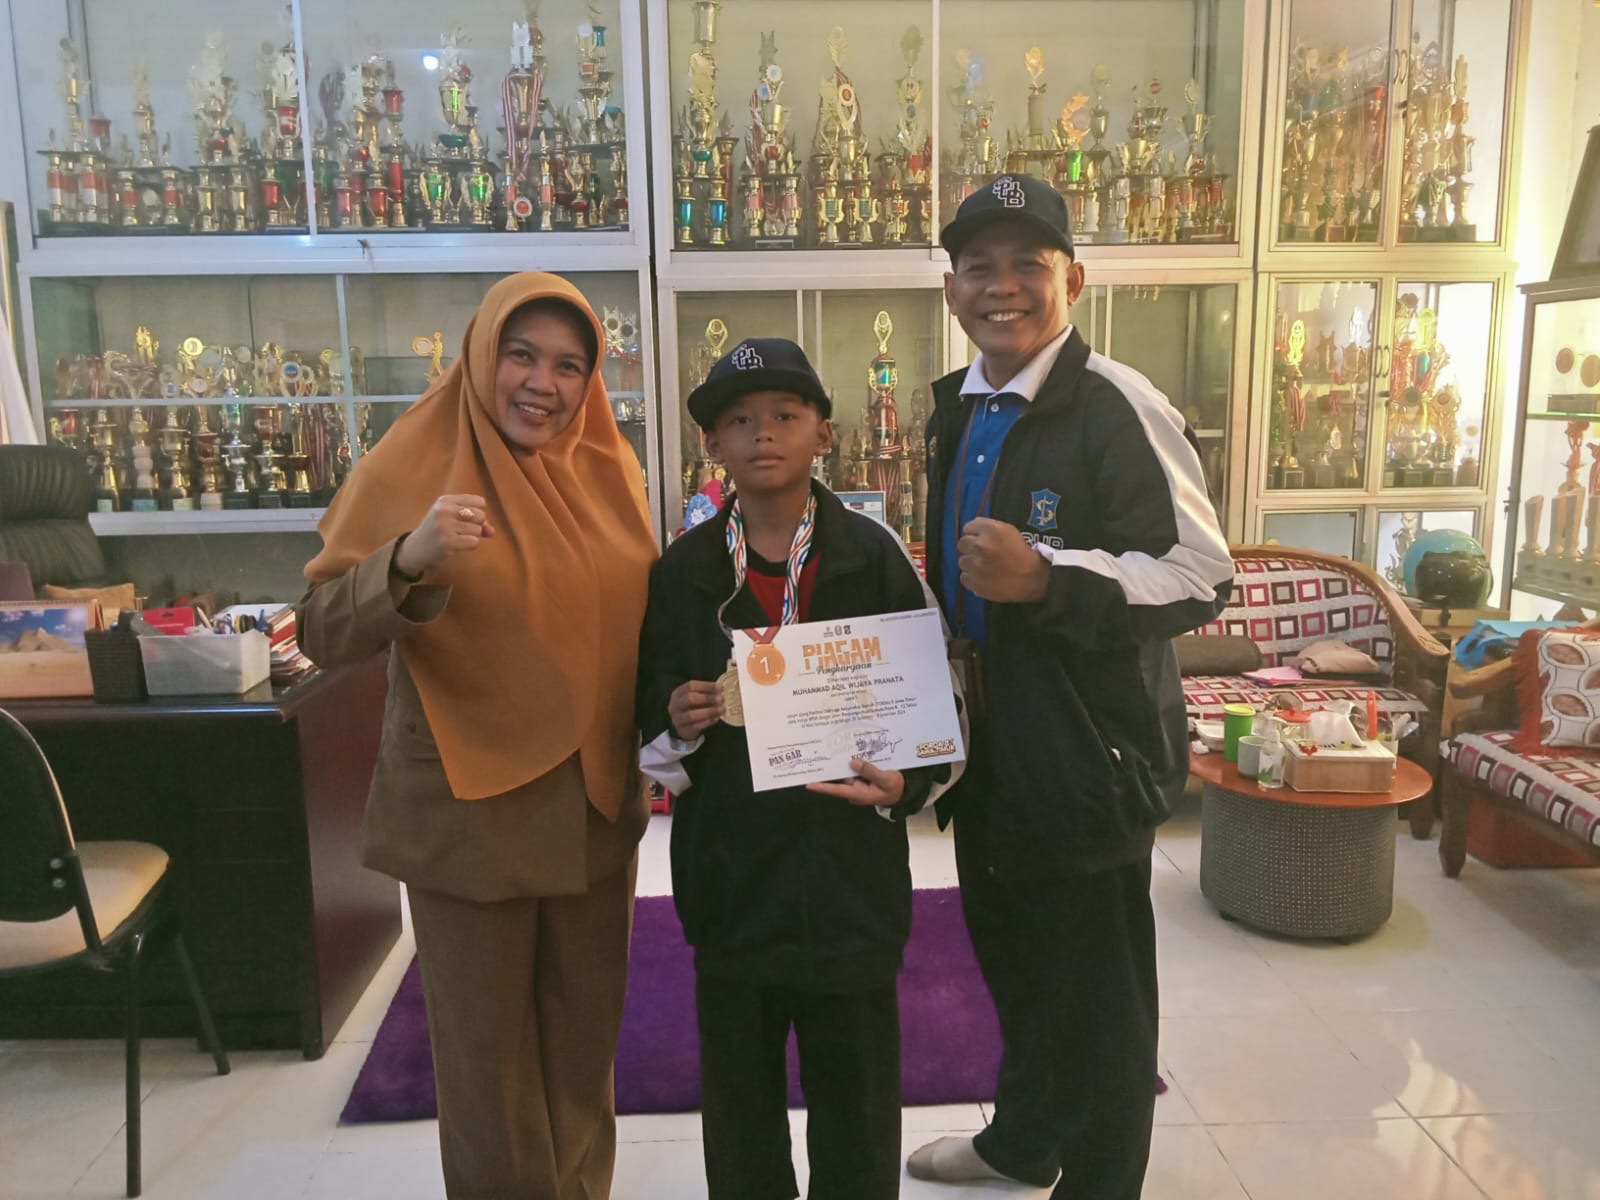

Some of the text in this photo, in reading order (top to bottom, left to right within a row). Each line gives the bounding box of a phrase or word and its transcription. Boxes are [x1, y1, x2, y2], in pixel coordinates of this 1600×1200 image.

[802, 636, 882, 670] PIAGAM
[759, 655, 770, 675] 1
[792, 685, 831, 697] MUHAMMAD
[873, 675, 905, 686] PRANATA
